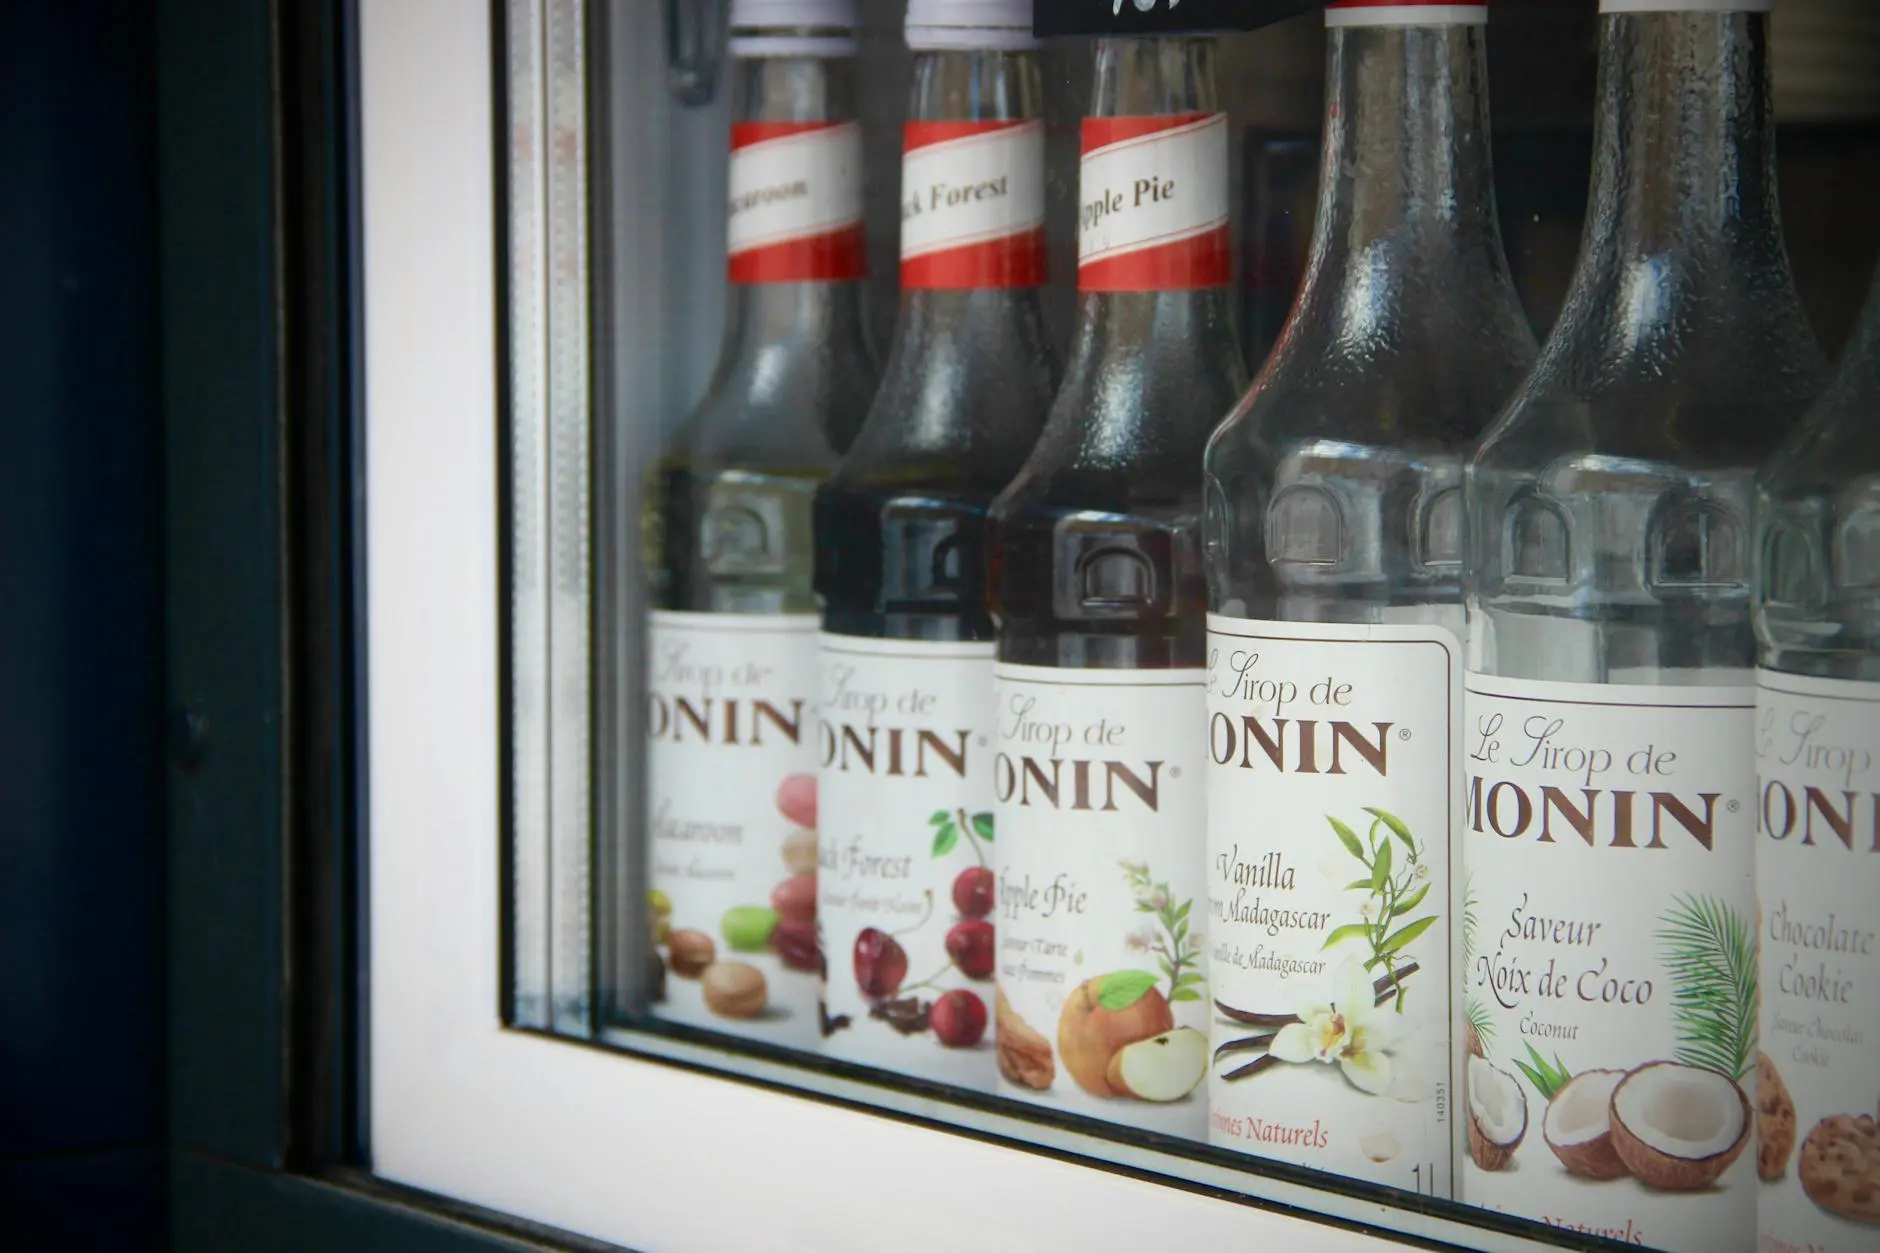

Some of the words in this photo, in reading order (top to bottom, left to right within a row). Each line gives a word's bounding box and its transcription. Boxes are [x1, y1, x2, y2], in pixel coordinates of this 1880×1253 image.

[930, 175, 1008, 212] Forest
[1133, 175, 1175, 208] Pie
[1221, 650, 1298, 716] Sirop
[1309, 677, 1353, 706] de
[1002, 693, 1072, 758] Sirop
[1084, 718, 1127, 746] de
[1470, 713, 1504, 763] Le
[1510, 715, 1612, 786] Sirop
[1626, 744, 1677, 775] de
[1779, 710, 1872, 788] Sirop
[1216, 844, 1296, 890] Vanilla
[1041, 872, 1088, 918] Pie
[1222, 887, 1331, 936] Madagascar
[1500, 892, 1601, 949] Saveur
[1769, 899, 1876, 956] Chocolate
[1241, 944, 1326, 979] Madagascar
[1477, 951, 1532, 1009] Noix
[1538, 962, 1568, 999] de
[1576, 958, 1654, 1005] Coco
[1778, 953, 1854, 1004] Cookie
[1519, 1010, 1580, 1041] Coconut
[1436, 1082, 1446, 1123] 140351
[1246, 1116, 1329, 1149] Naturels
